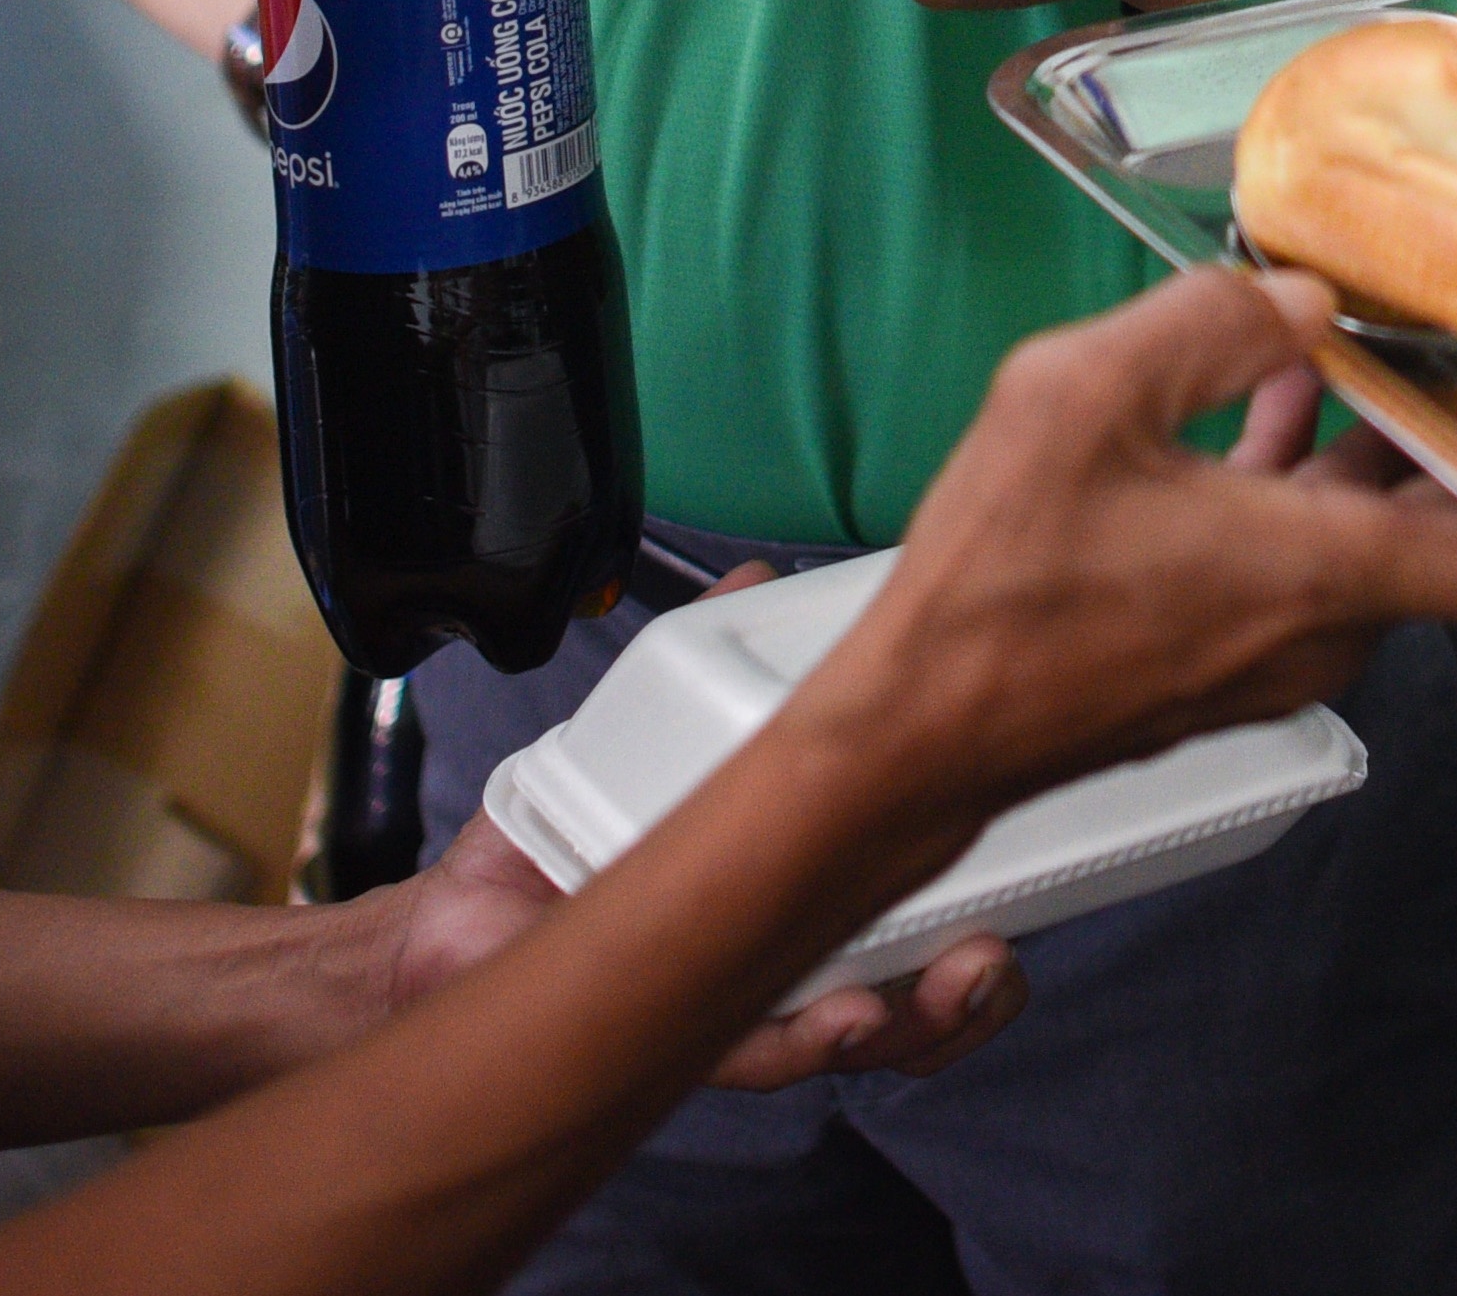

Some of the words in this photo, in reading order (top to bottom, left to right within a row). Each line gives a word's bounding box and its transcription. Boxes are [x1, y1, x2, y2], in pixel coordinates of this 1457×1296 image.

[485, 18, 523, 86] UỐNG
[524, 14, 550, 76] COLA
[494, 87, 528, 151] NƯỚC
[528, 76, 556, 142] PEPSI
[511, 191, 519, 204] 8
